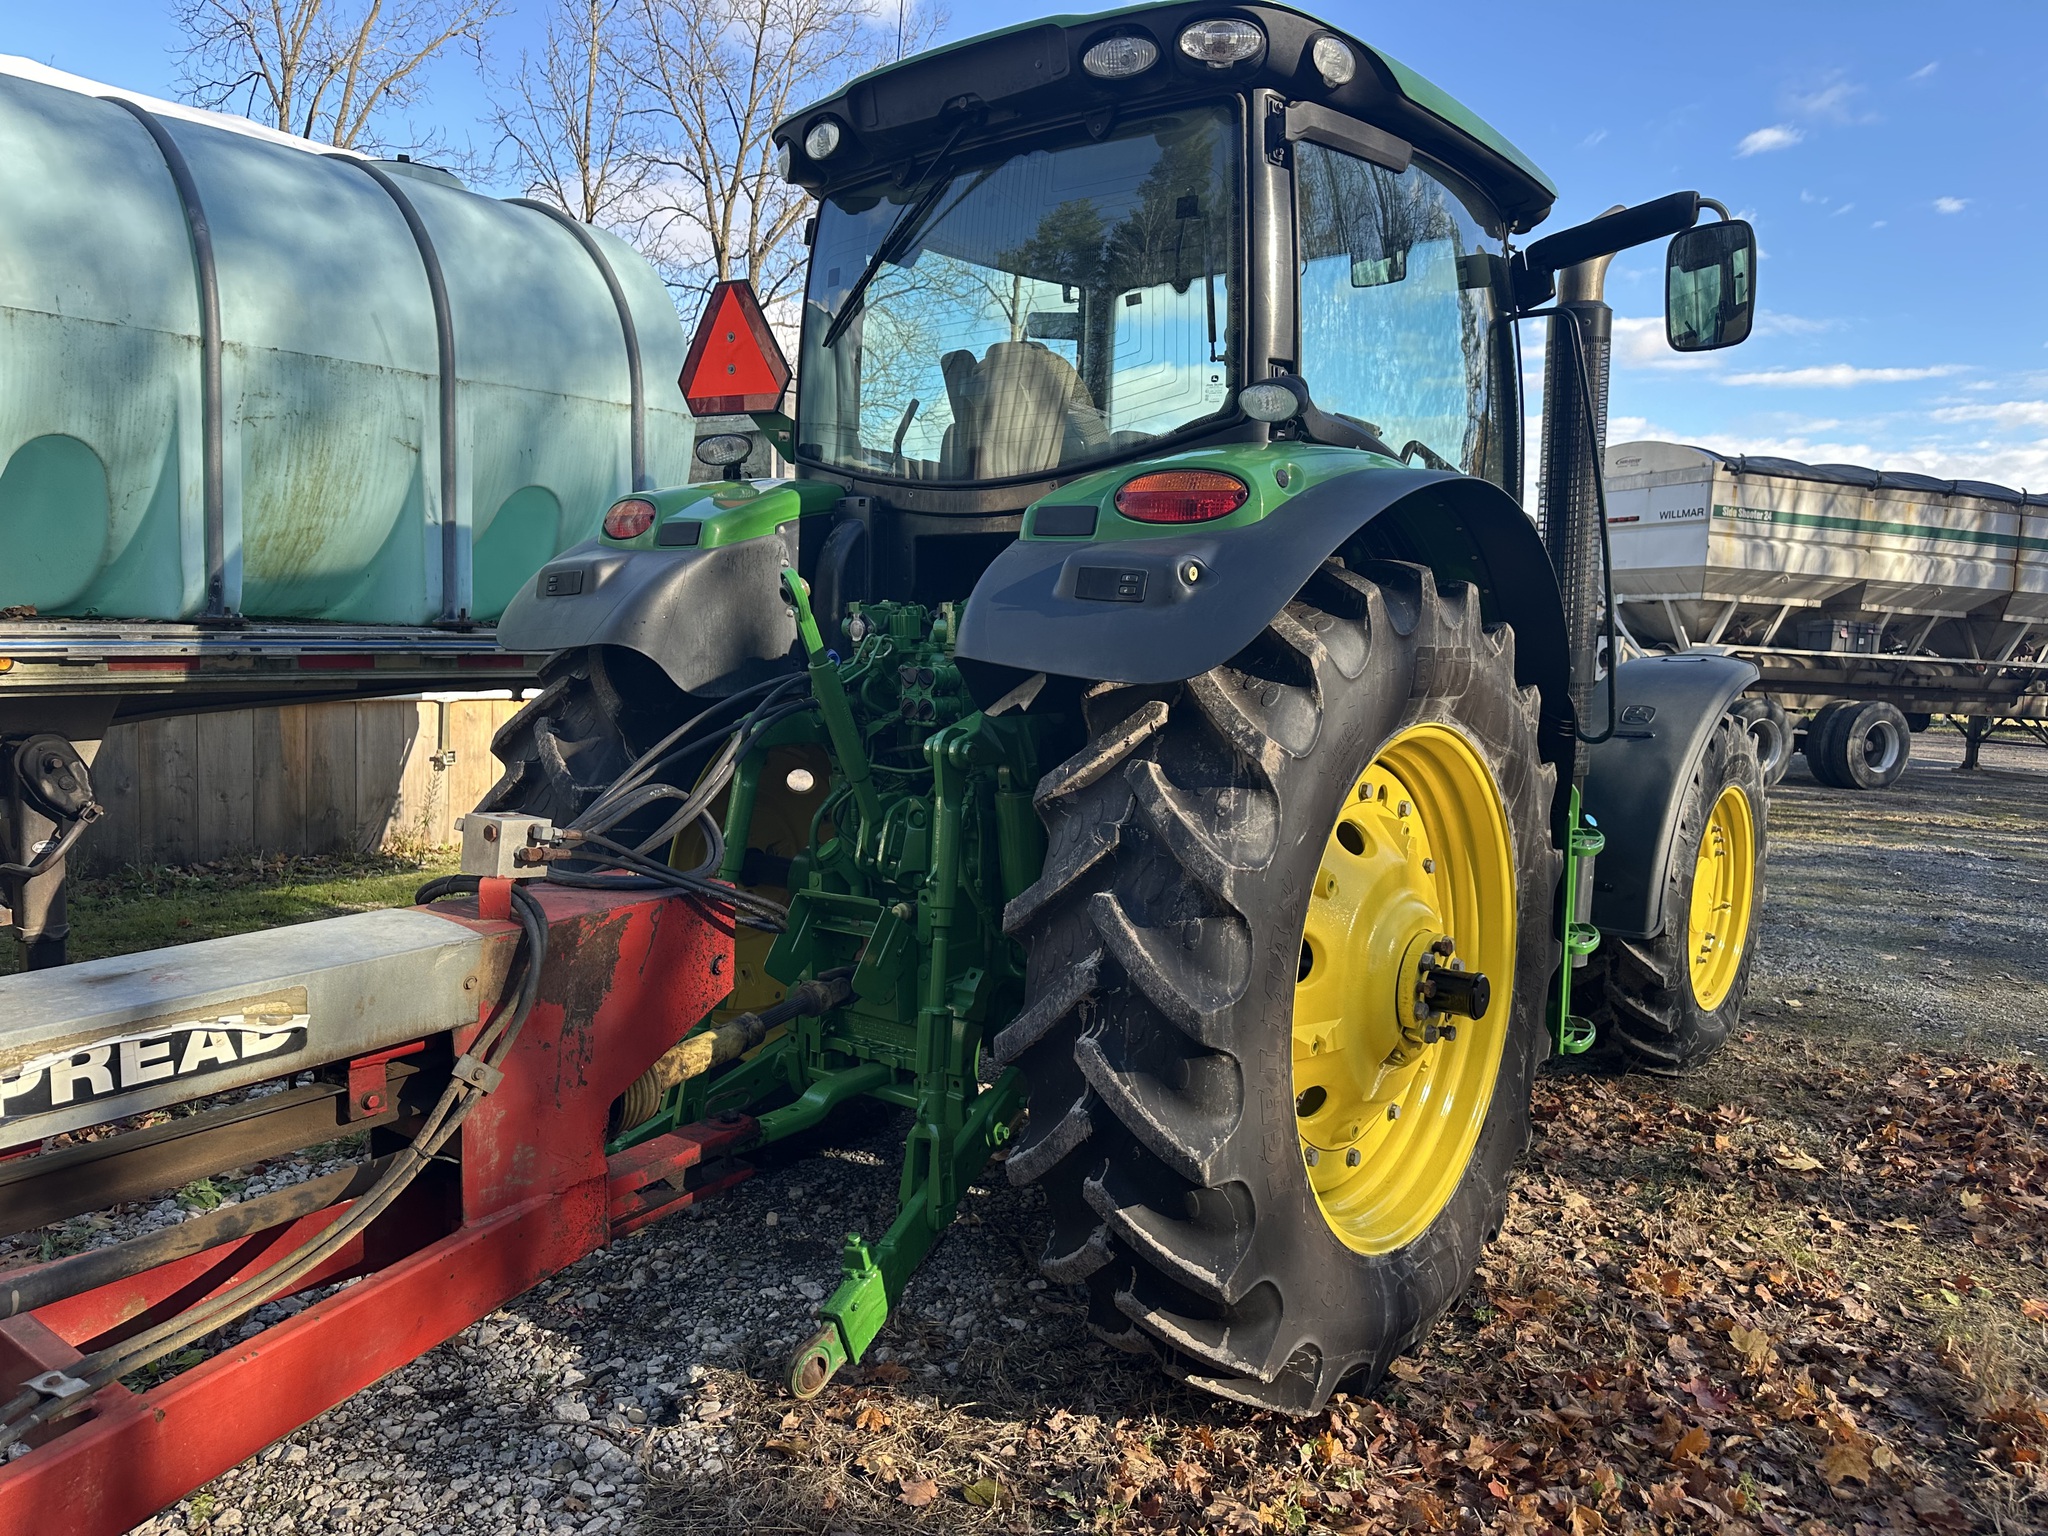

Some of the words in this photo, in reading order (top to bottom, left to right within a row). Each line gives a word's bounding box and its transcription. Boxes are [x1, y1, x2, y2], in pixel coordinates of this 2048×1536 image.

[1659, 507, 1704, 519] WILLMAR
[1722, 506, 1737, 517] Side
[1738, 507, 1763, 520] Shooter
[1763, 510, 1773, 521] 24
